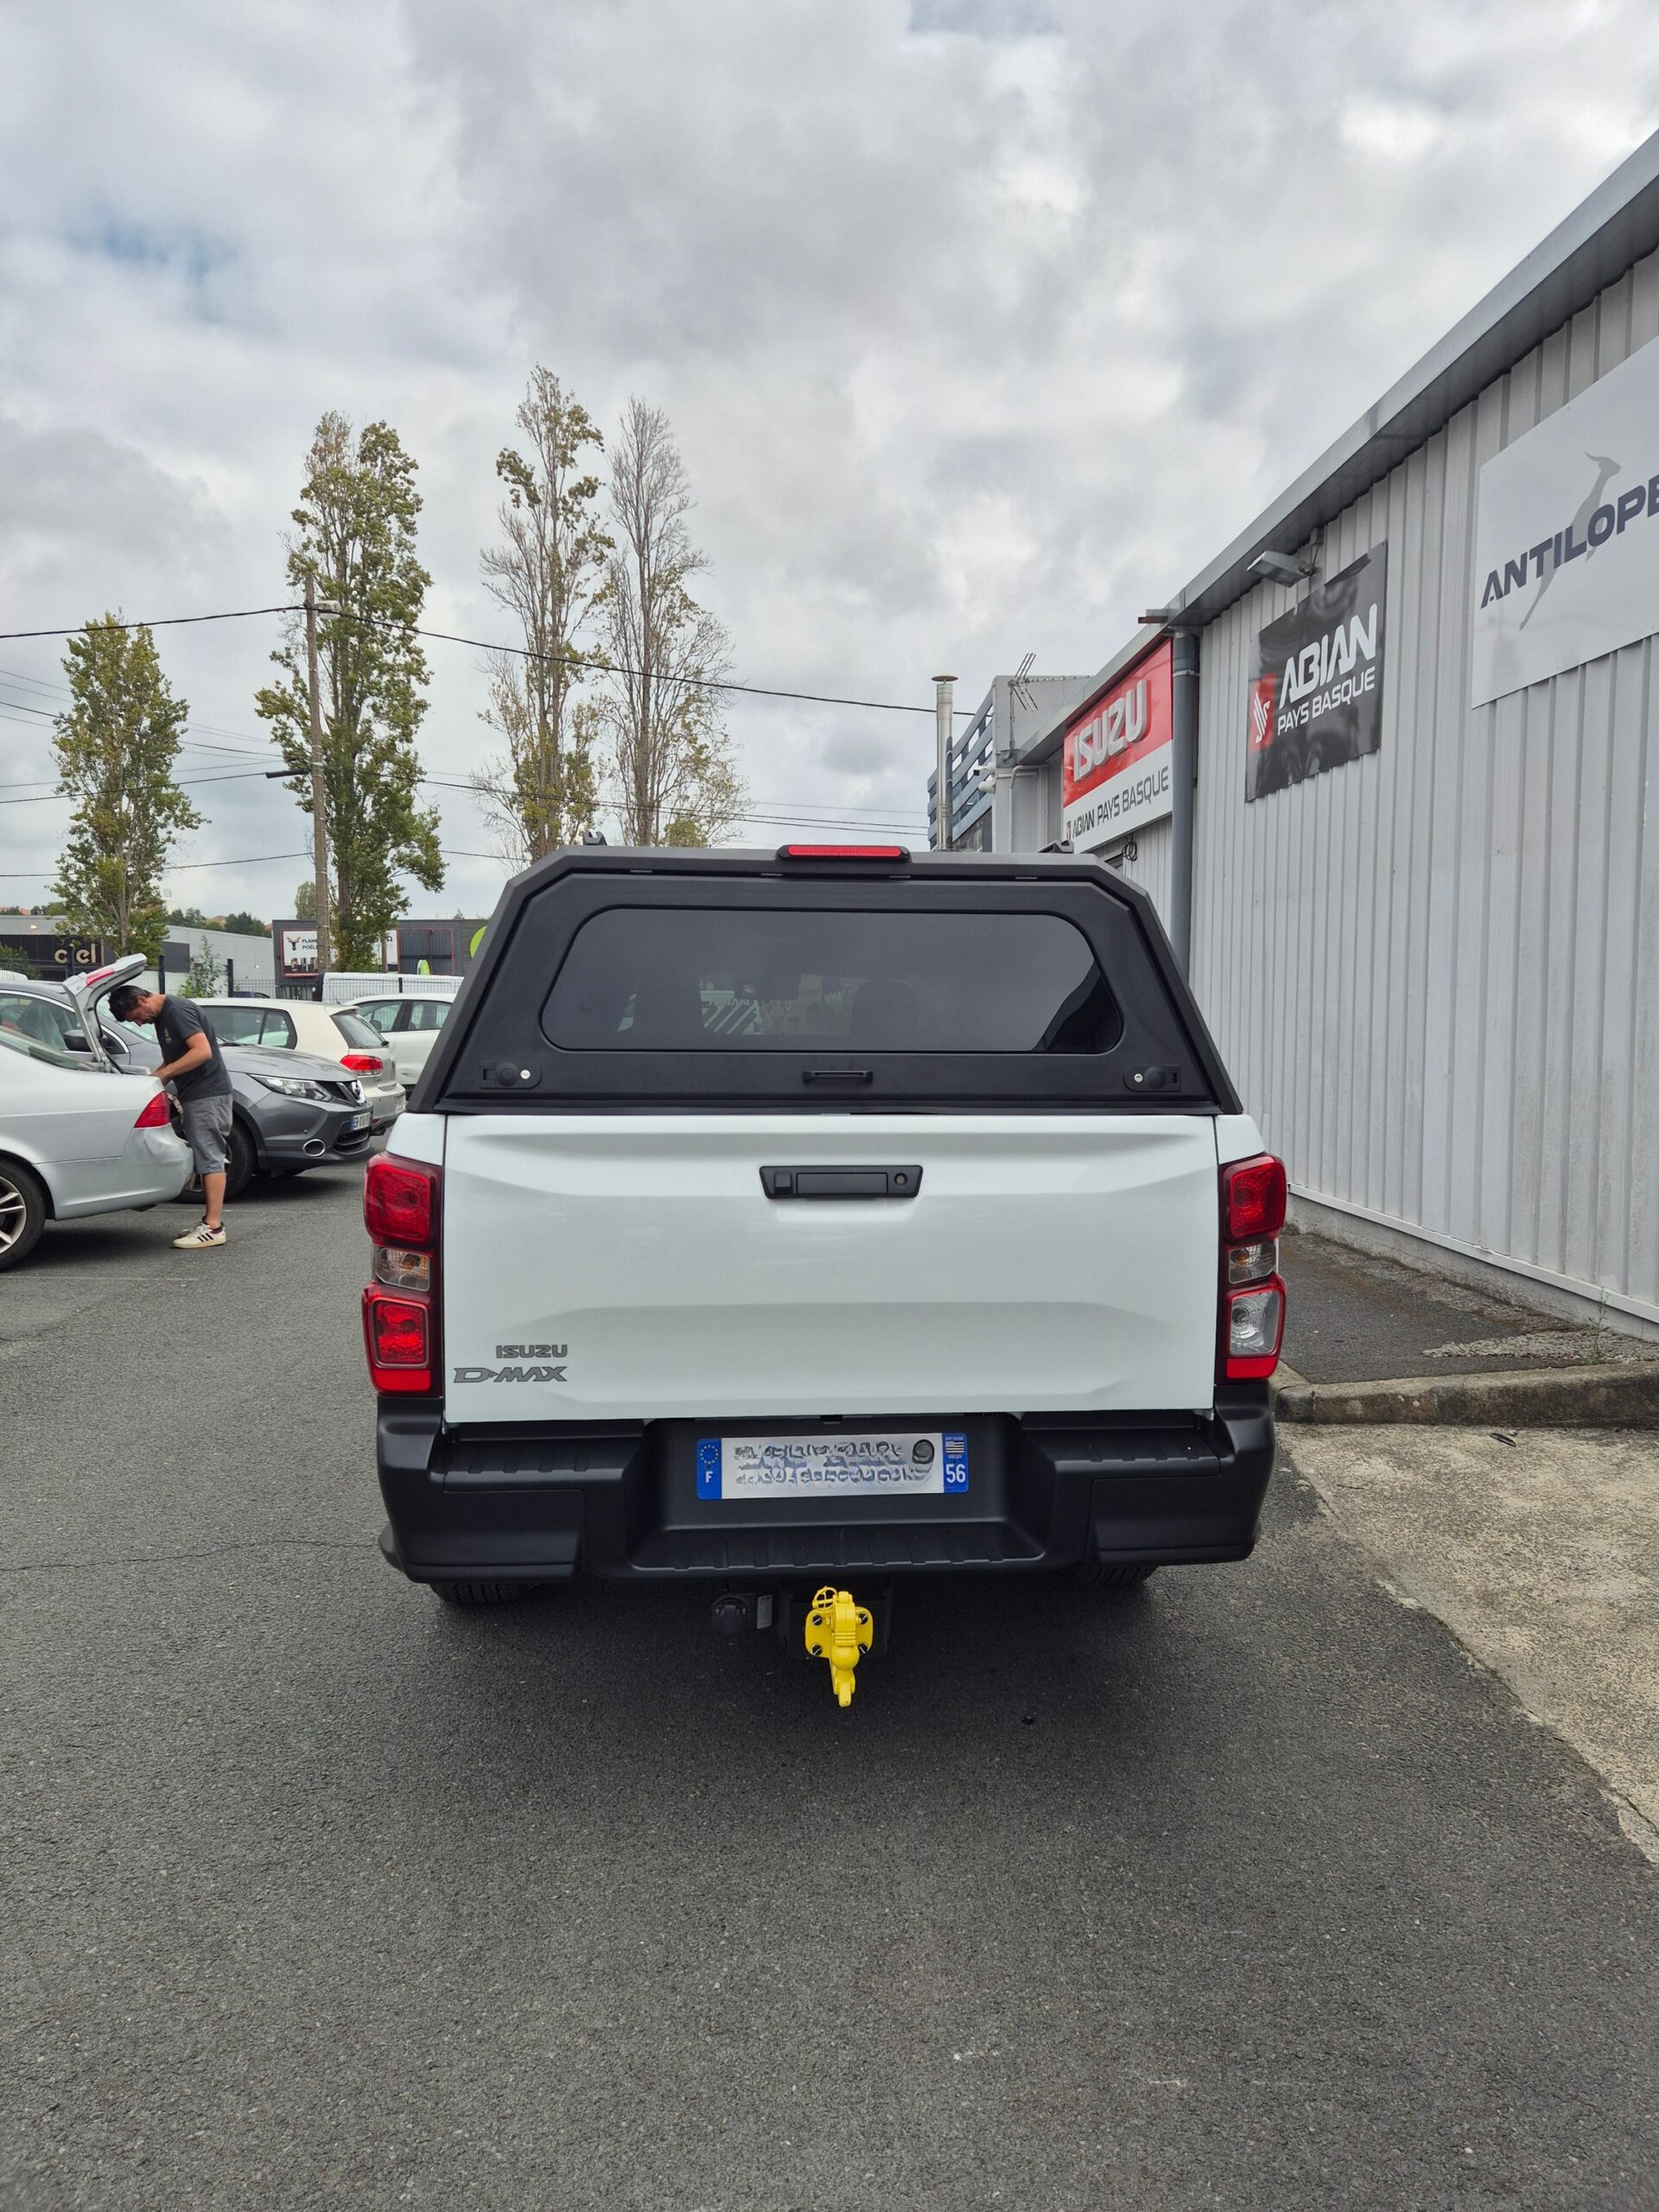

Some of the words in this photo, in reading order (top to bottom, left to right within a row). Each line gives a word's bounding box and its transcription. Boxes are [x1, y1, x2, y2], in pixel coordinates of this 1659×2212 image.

[1279, 603, 1377, 710] ABIAN
[1278, 702, 1309, 736] PAYS
[1312, 666, 1376, 719] BASQUE
[1074, 679, 1147, 782] ISUZU
[1072, 808, 1095, 839] ABIAN
[1097, 794, 1120, 825] PAYS
[1122, 766, 1169, 813] BASQUE
[54, 943, 97, 964] cel
[496, 1344, 568, 1358] ISUZU
[453, 1366, 568, 1383] D-MAX
[705, 1471, 714, 1484] F
[945, 1463, 966, 1484] 56
